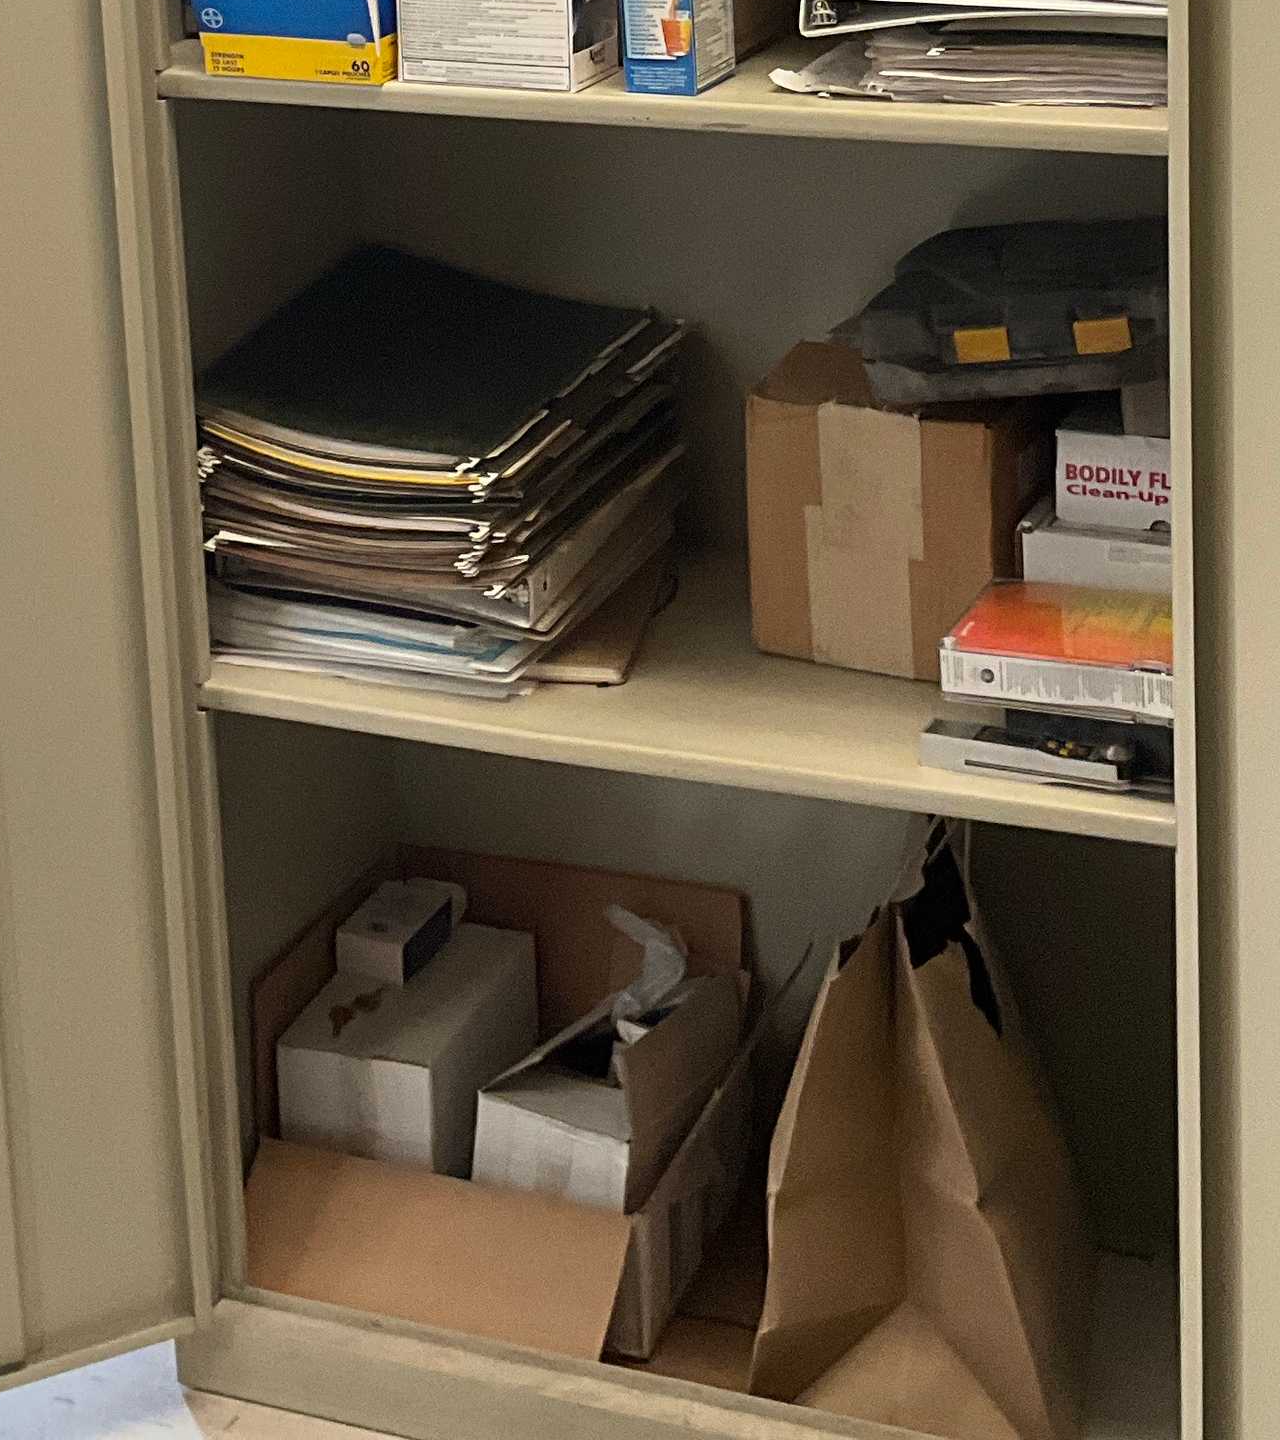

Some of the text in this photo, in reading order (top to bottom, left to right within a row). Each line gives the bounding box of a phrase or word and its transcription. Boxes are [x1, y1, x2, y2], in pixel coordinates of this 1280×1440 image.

[351, 60, 370, 73] 60
[1065, 463, 1141, 487] BODILY
[1066, 484, 1169, 506] Clean-Up
